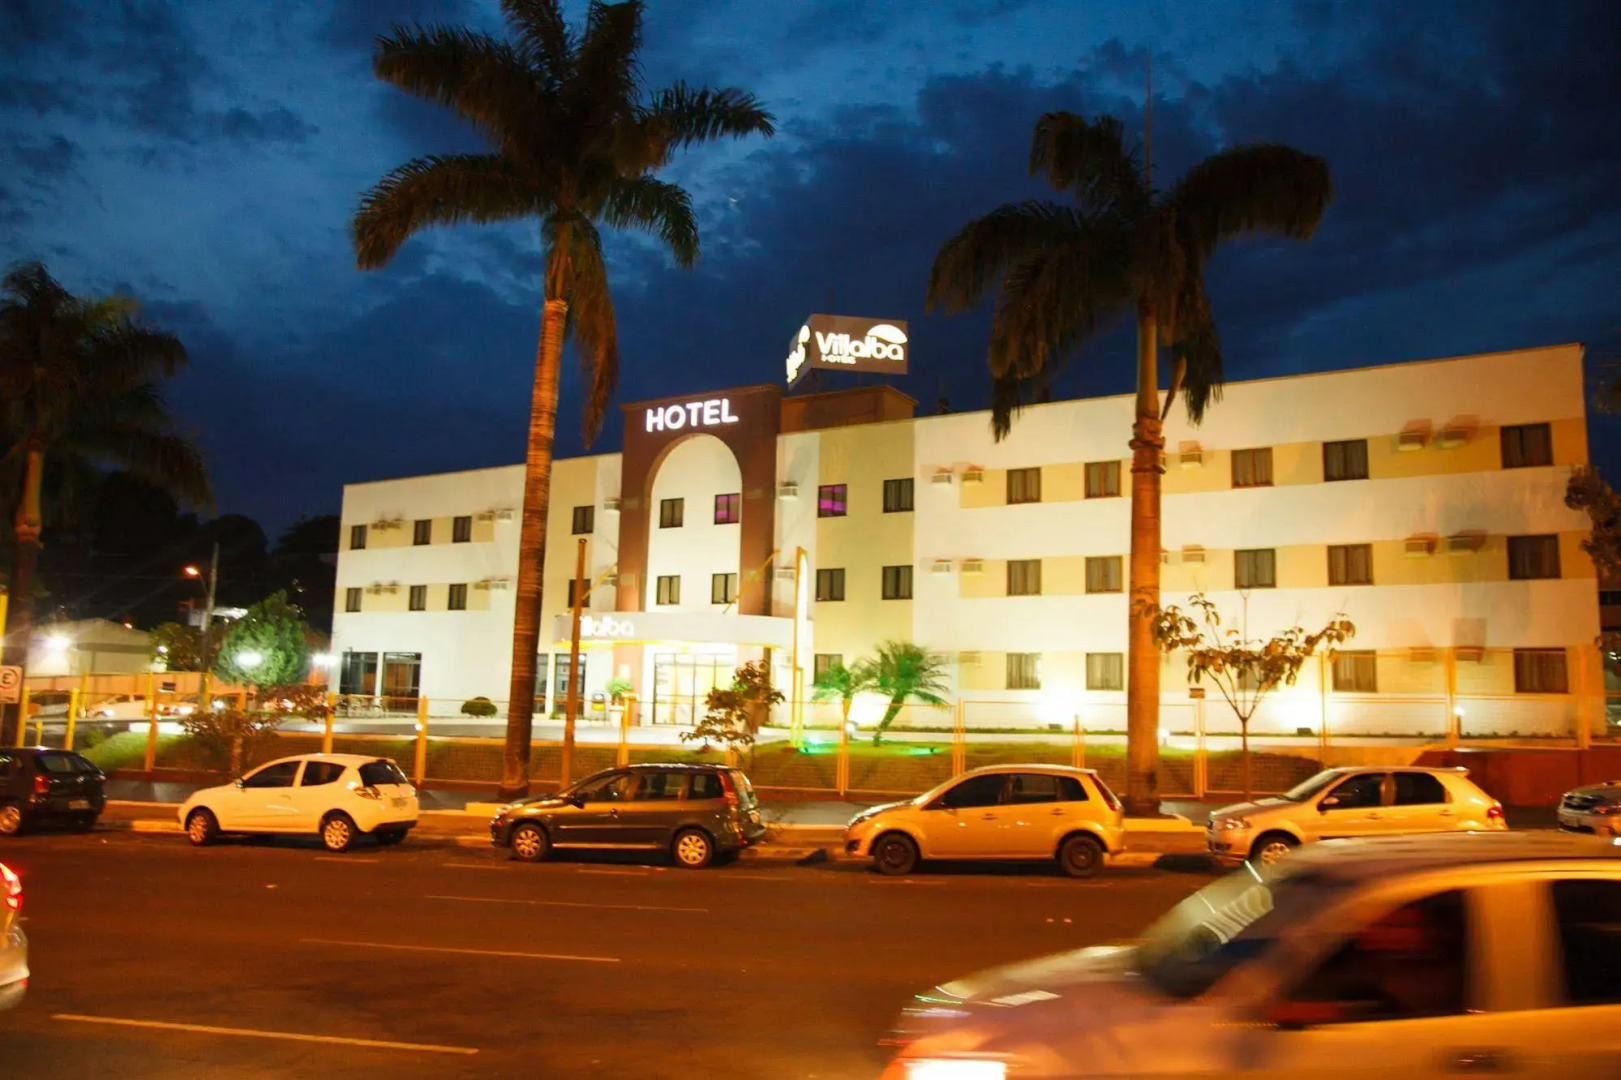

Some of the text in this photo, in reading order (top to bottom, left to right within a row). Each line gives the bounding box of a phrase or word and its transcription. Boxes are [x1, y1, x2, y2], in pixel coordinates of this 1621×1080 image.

[815, 331, 904, 361] Villalba
[646, 398, 739, 432] HOTEL
[2, 672, 12, 685] E
